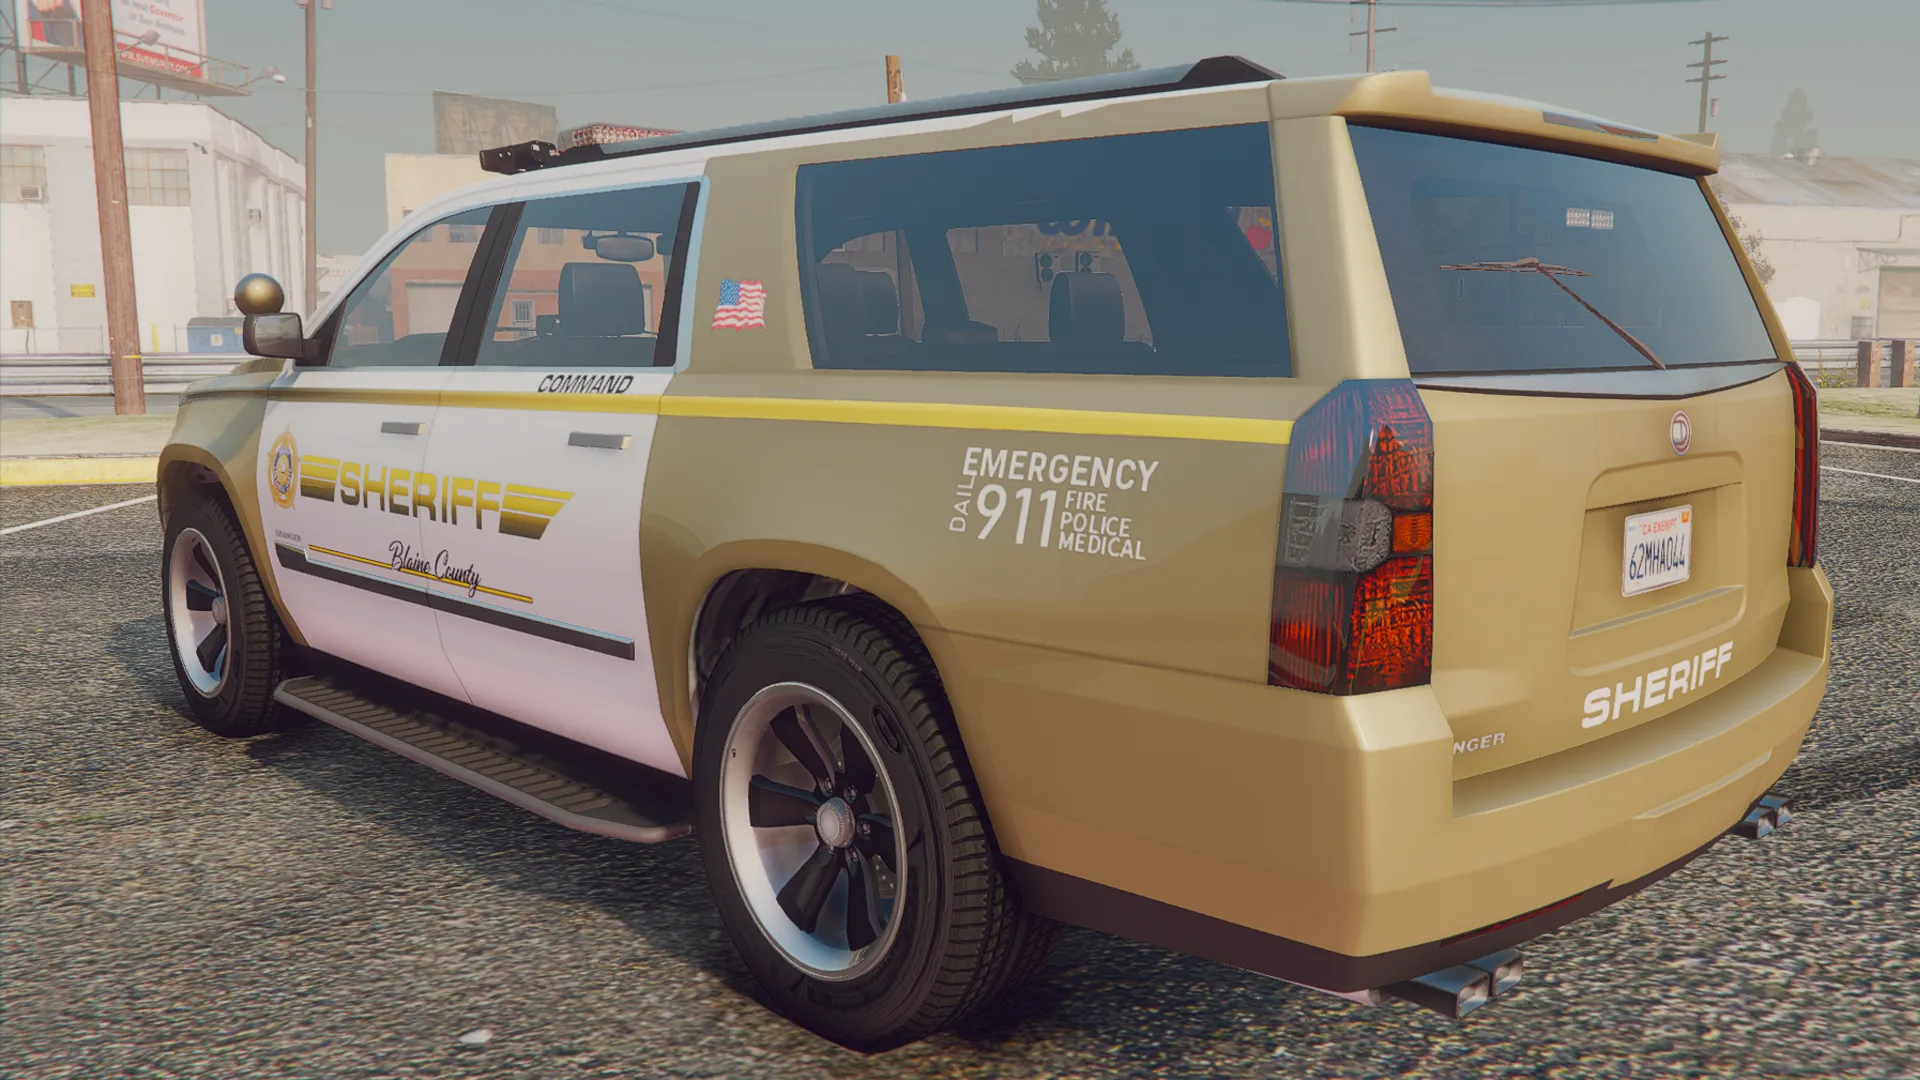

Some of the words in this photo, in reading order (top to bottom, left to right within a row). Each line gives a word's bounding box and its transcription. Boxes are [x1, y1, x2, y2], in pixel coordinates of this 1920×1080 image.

[537, 374, 635, 395] COMMAND
[962, 446, 1159, 492] EMERGENCY
[339, 461, 501, 531] SHERIFF
[949, 475, 976, 532] DAIL
[976, 483, 1058, 548] 911
[1064, 490, 1109, 513] FIRE
[1058, 530, 1146, 561] MEDICAL
[1059, 511, 1132, 538] POLICE
[1641, 522, 1652, 535] CA
[1653, 518, 1677, 533] EXEMPT
[388, 540, 431, 574] Blaine
[434, 549, 482, 599] County
[1629, 533, 1685, 580] 62MHA044
[1581, 640, 1734, 729] SHERIFF
[1453, 731, 1506, 755] NGER
